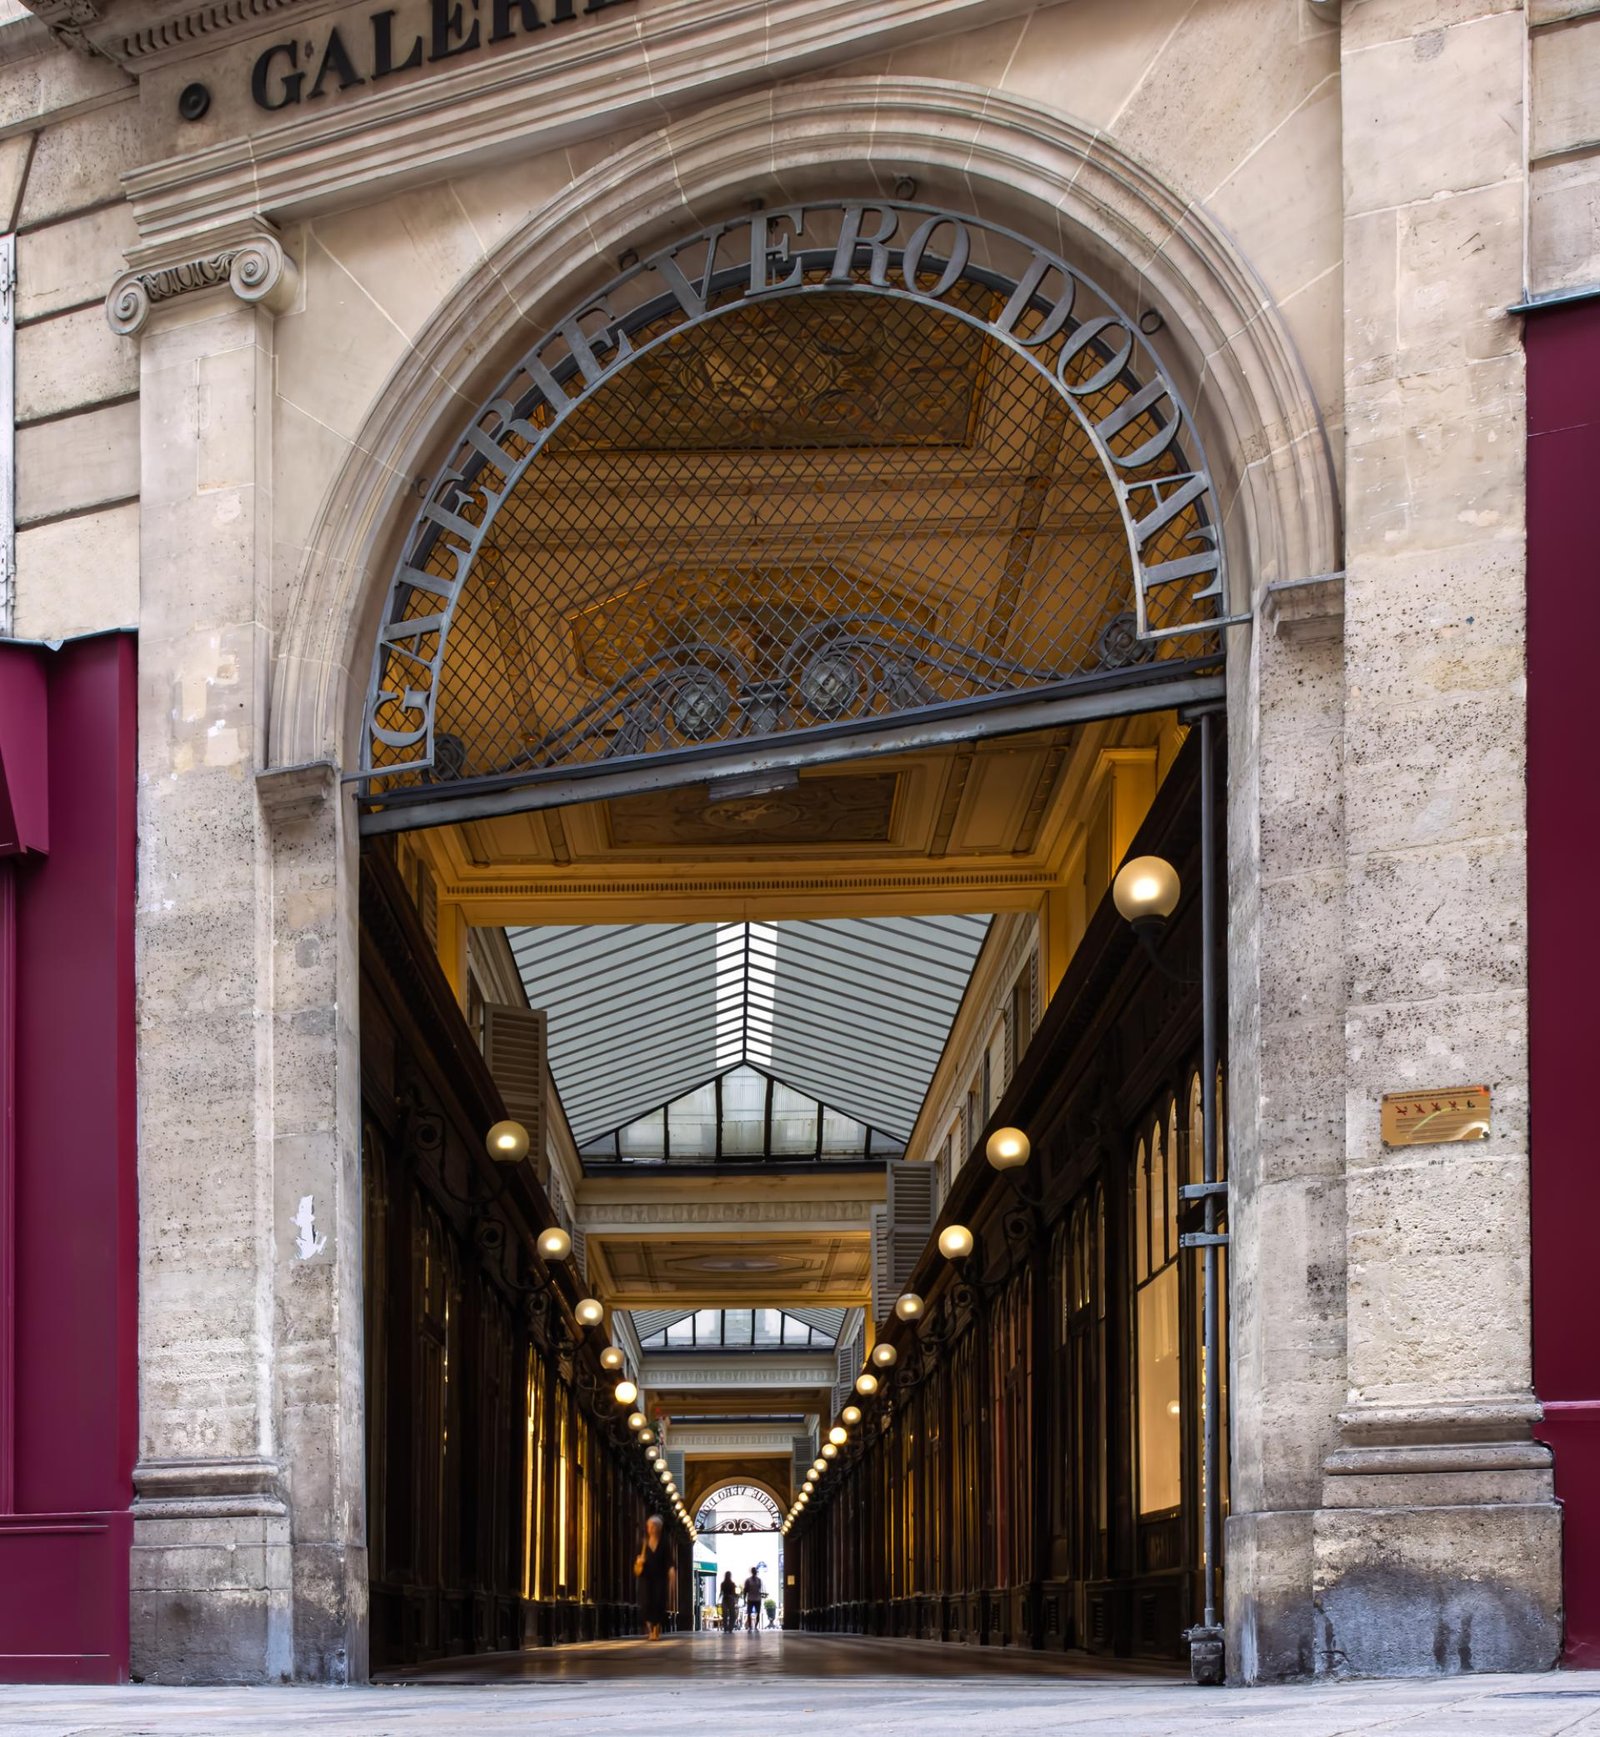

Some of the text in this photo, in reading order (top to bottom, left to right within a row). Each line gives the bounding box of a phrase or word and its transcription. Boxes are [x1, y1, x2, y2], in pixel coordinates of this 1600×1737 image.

[251, 0, 638, 111] GALER
[369, 201, 1223, 747] GALERIE VERO DODAT
